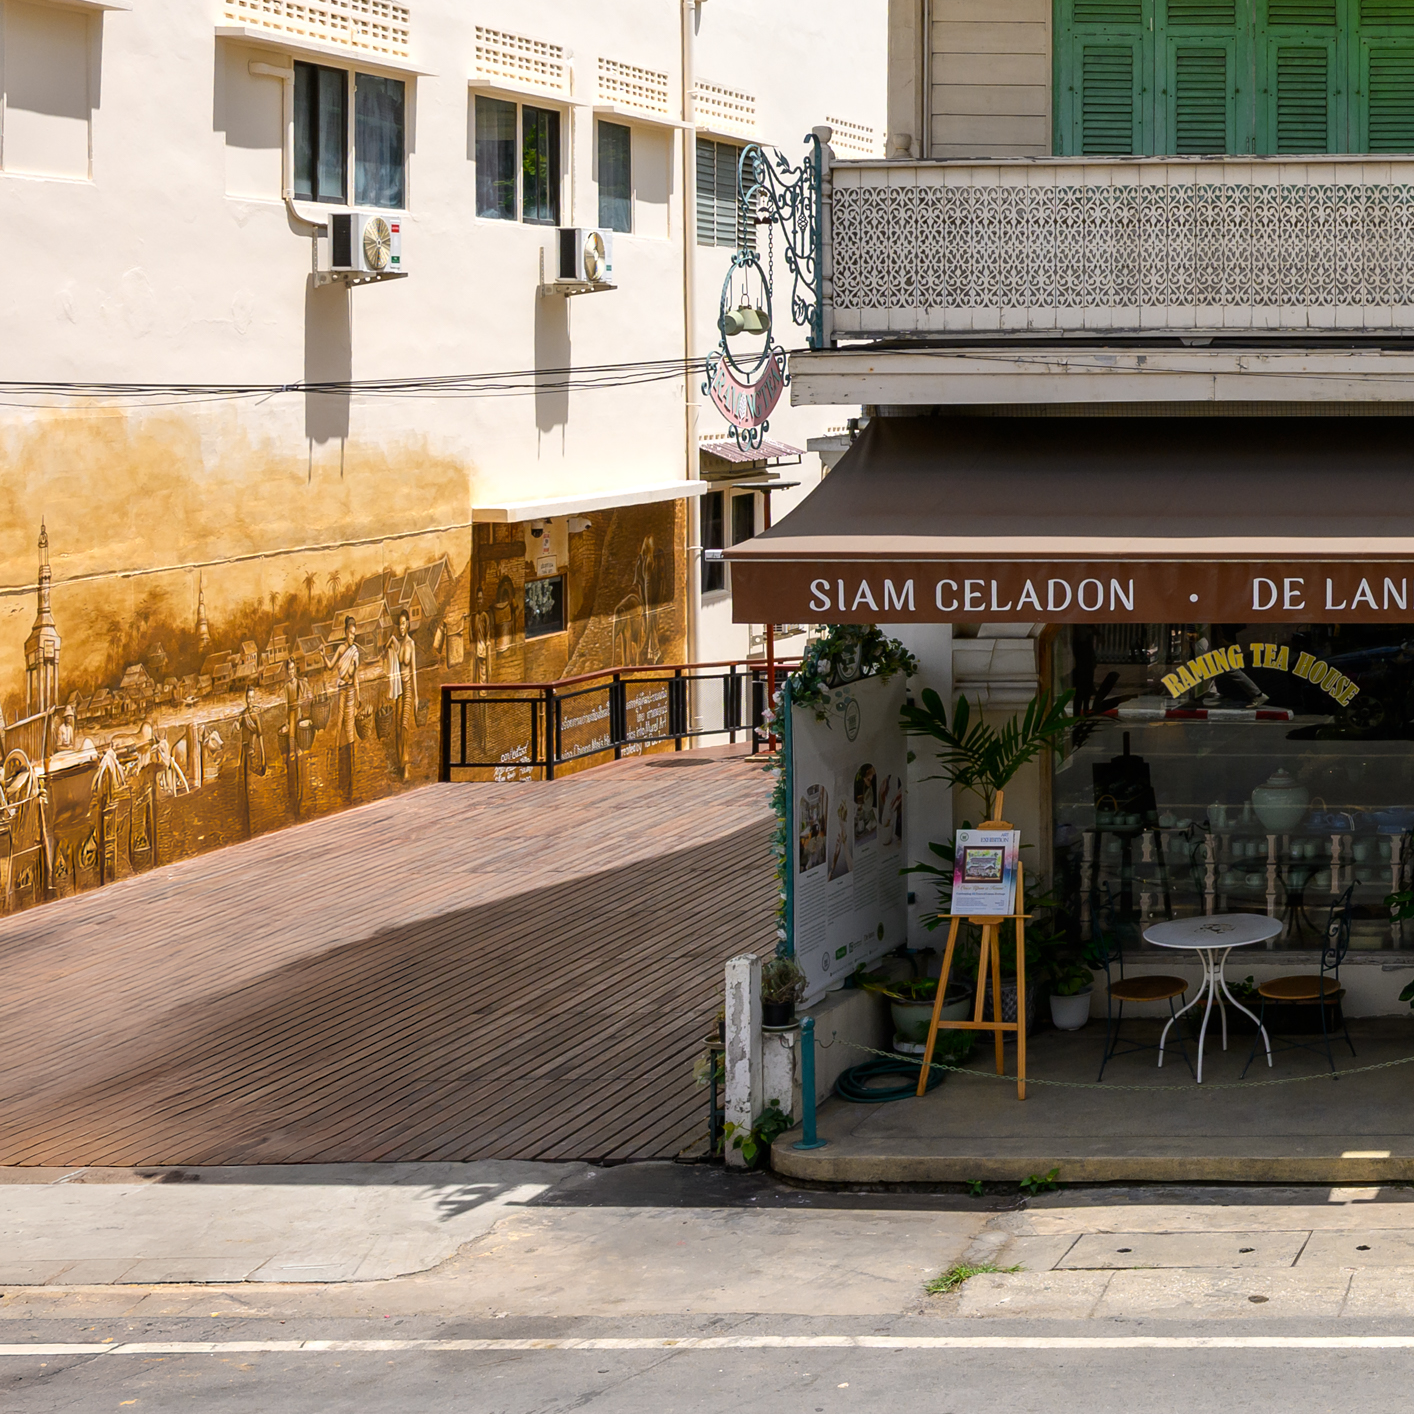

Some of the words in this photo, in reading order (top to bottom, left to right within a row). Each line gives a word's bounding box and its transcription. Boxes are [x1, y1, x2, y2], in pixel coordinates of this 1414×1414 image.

[809, 578, 916, 612] SIAM
[935, 578, 1134, 612] CELADON
[1252, 577, 1306, 610] DE
[1161, 643, 1245, 699] RAMING
[1249, 642, 1290, 672] TEA
[1292, 651, 1361, 708] HOUSE
